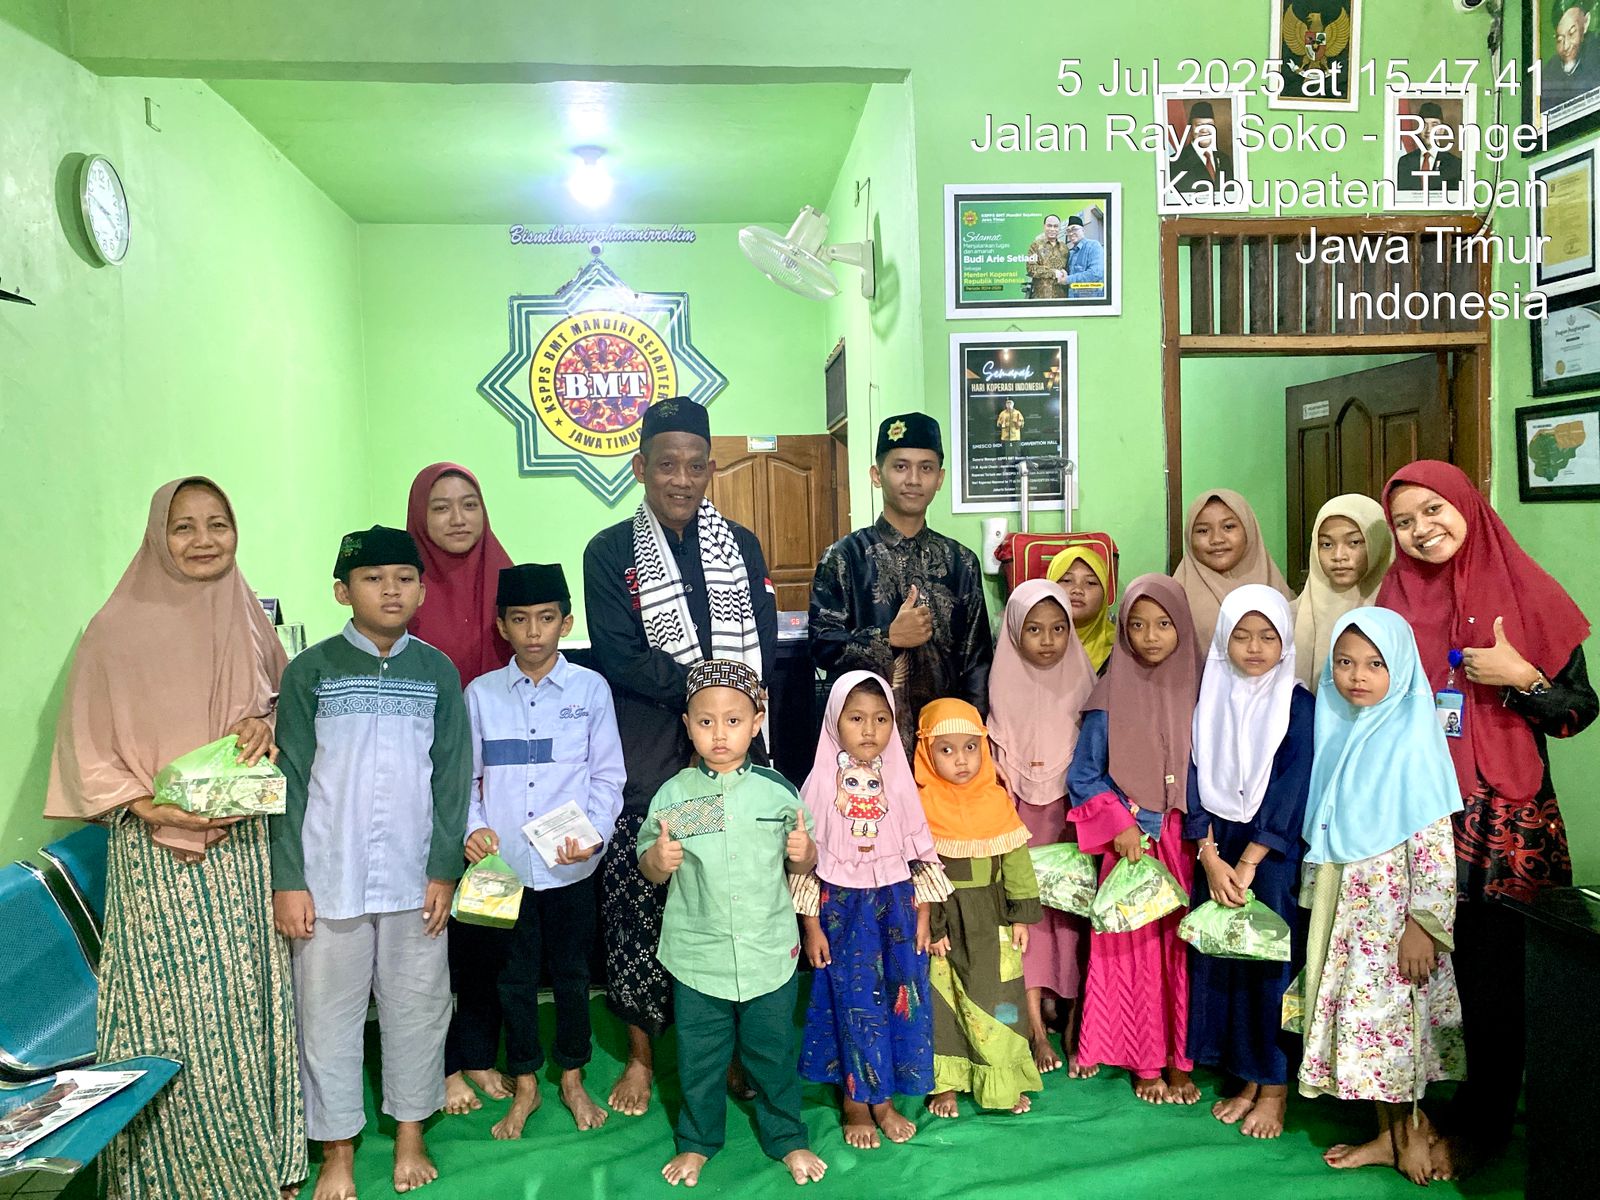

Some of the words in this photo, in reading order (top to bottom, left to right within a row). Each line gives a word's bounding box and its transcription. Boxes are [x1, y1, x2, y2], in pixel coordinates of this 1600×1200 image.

[962, 231, 1001, 243] Selamat
[963, 255, 985, 263] Budi
[986, 254, 1005, 263] Arie
[1007, 253, 1038, 262] Setiadi
[570, 318, 635, 336] MANDIRI
[543, 332, 568, 361] BMT
[982, 360, 1034, 382] Semarak
[538, 366, 557, 414] KSPPS
[561, 371, 647, 400] BMT
[971, 383, 985, 392] HARI
[986, 382, 1014, 392] KOPERASI
[1015, 382, 1045, 391] INDONESIA
[568, 429, 602, 449] JAWA
